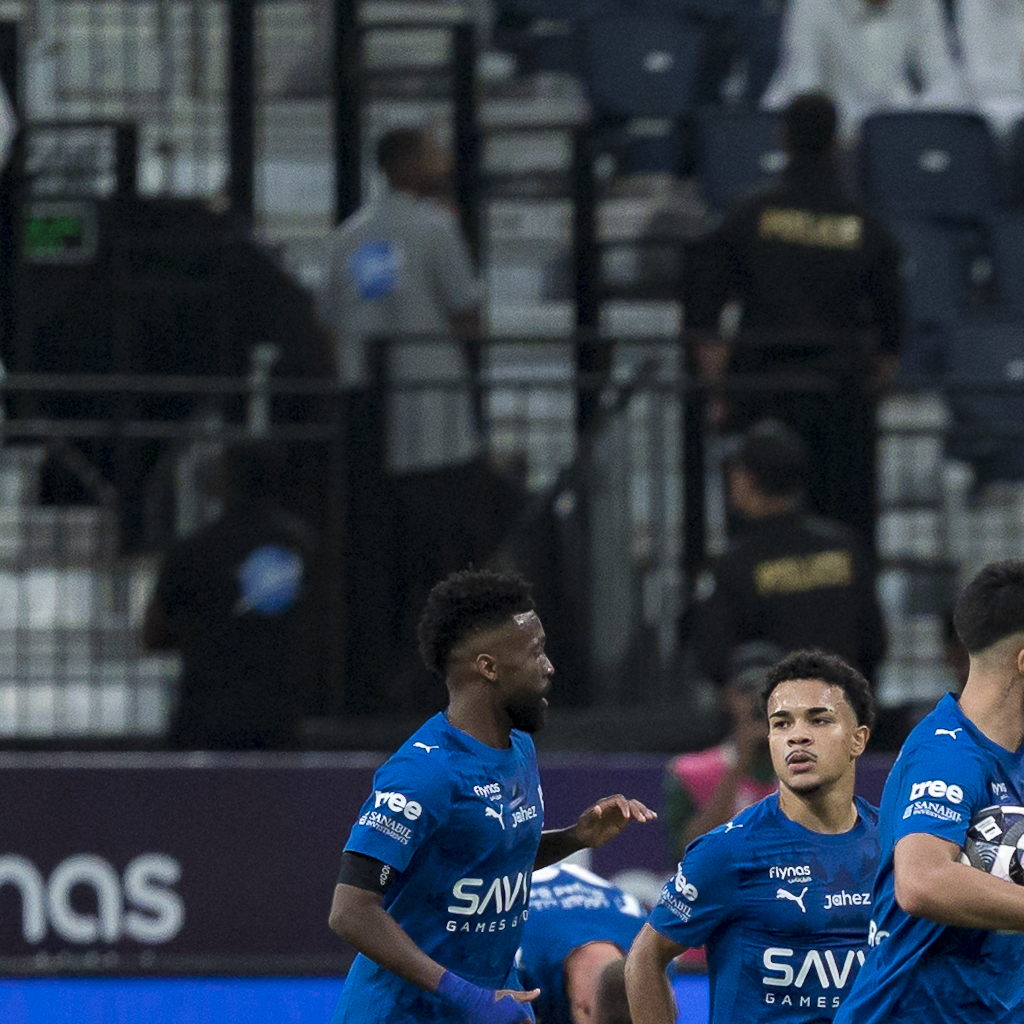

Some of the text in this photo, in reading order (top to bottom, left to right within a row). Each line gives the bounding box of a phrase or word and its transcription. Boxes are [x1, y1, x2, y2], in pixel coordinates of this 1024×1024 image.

[769, 865, 811, 880] flynas
[447, 871, 528, 916] SAV
[445, 918, 507, 933] GAMES
[763, 947, 866, 989] SAV
[764, 992, 841, 1008] GAMES
